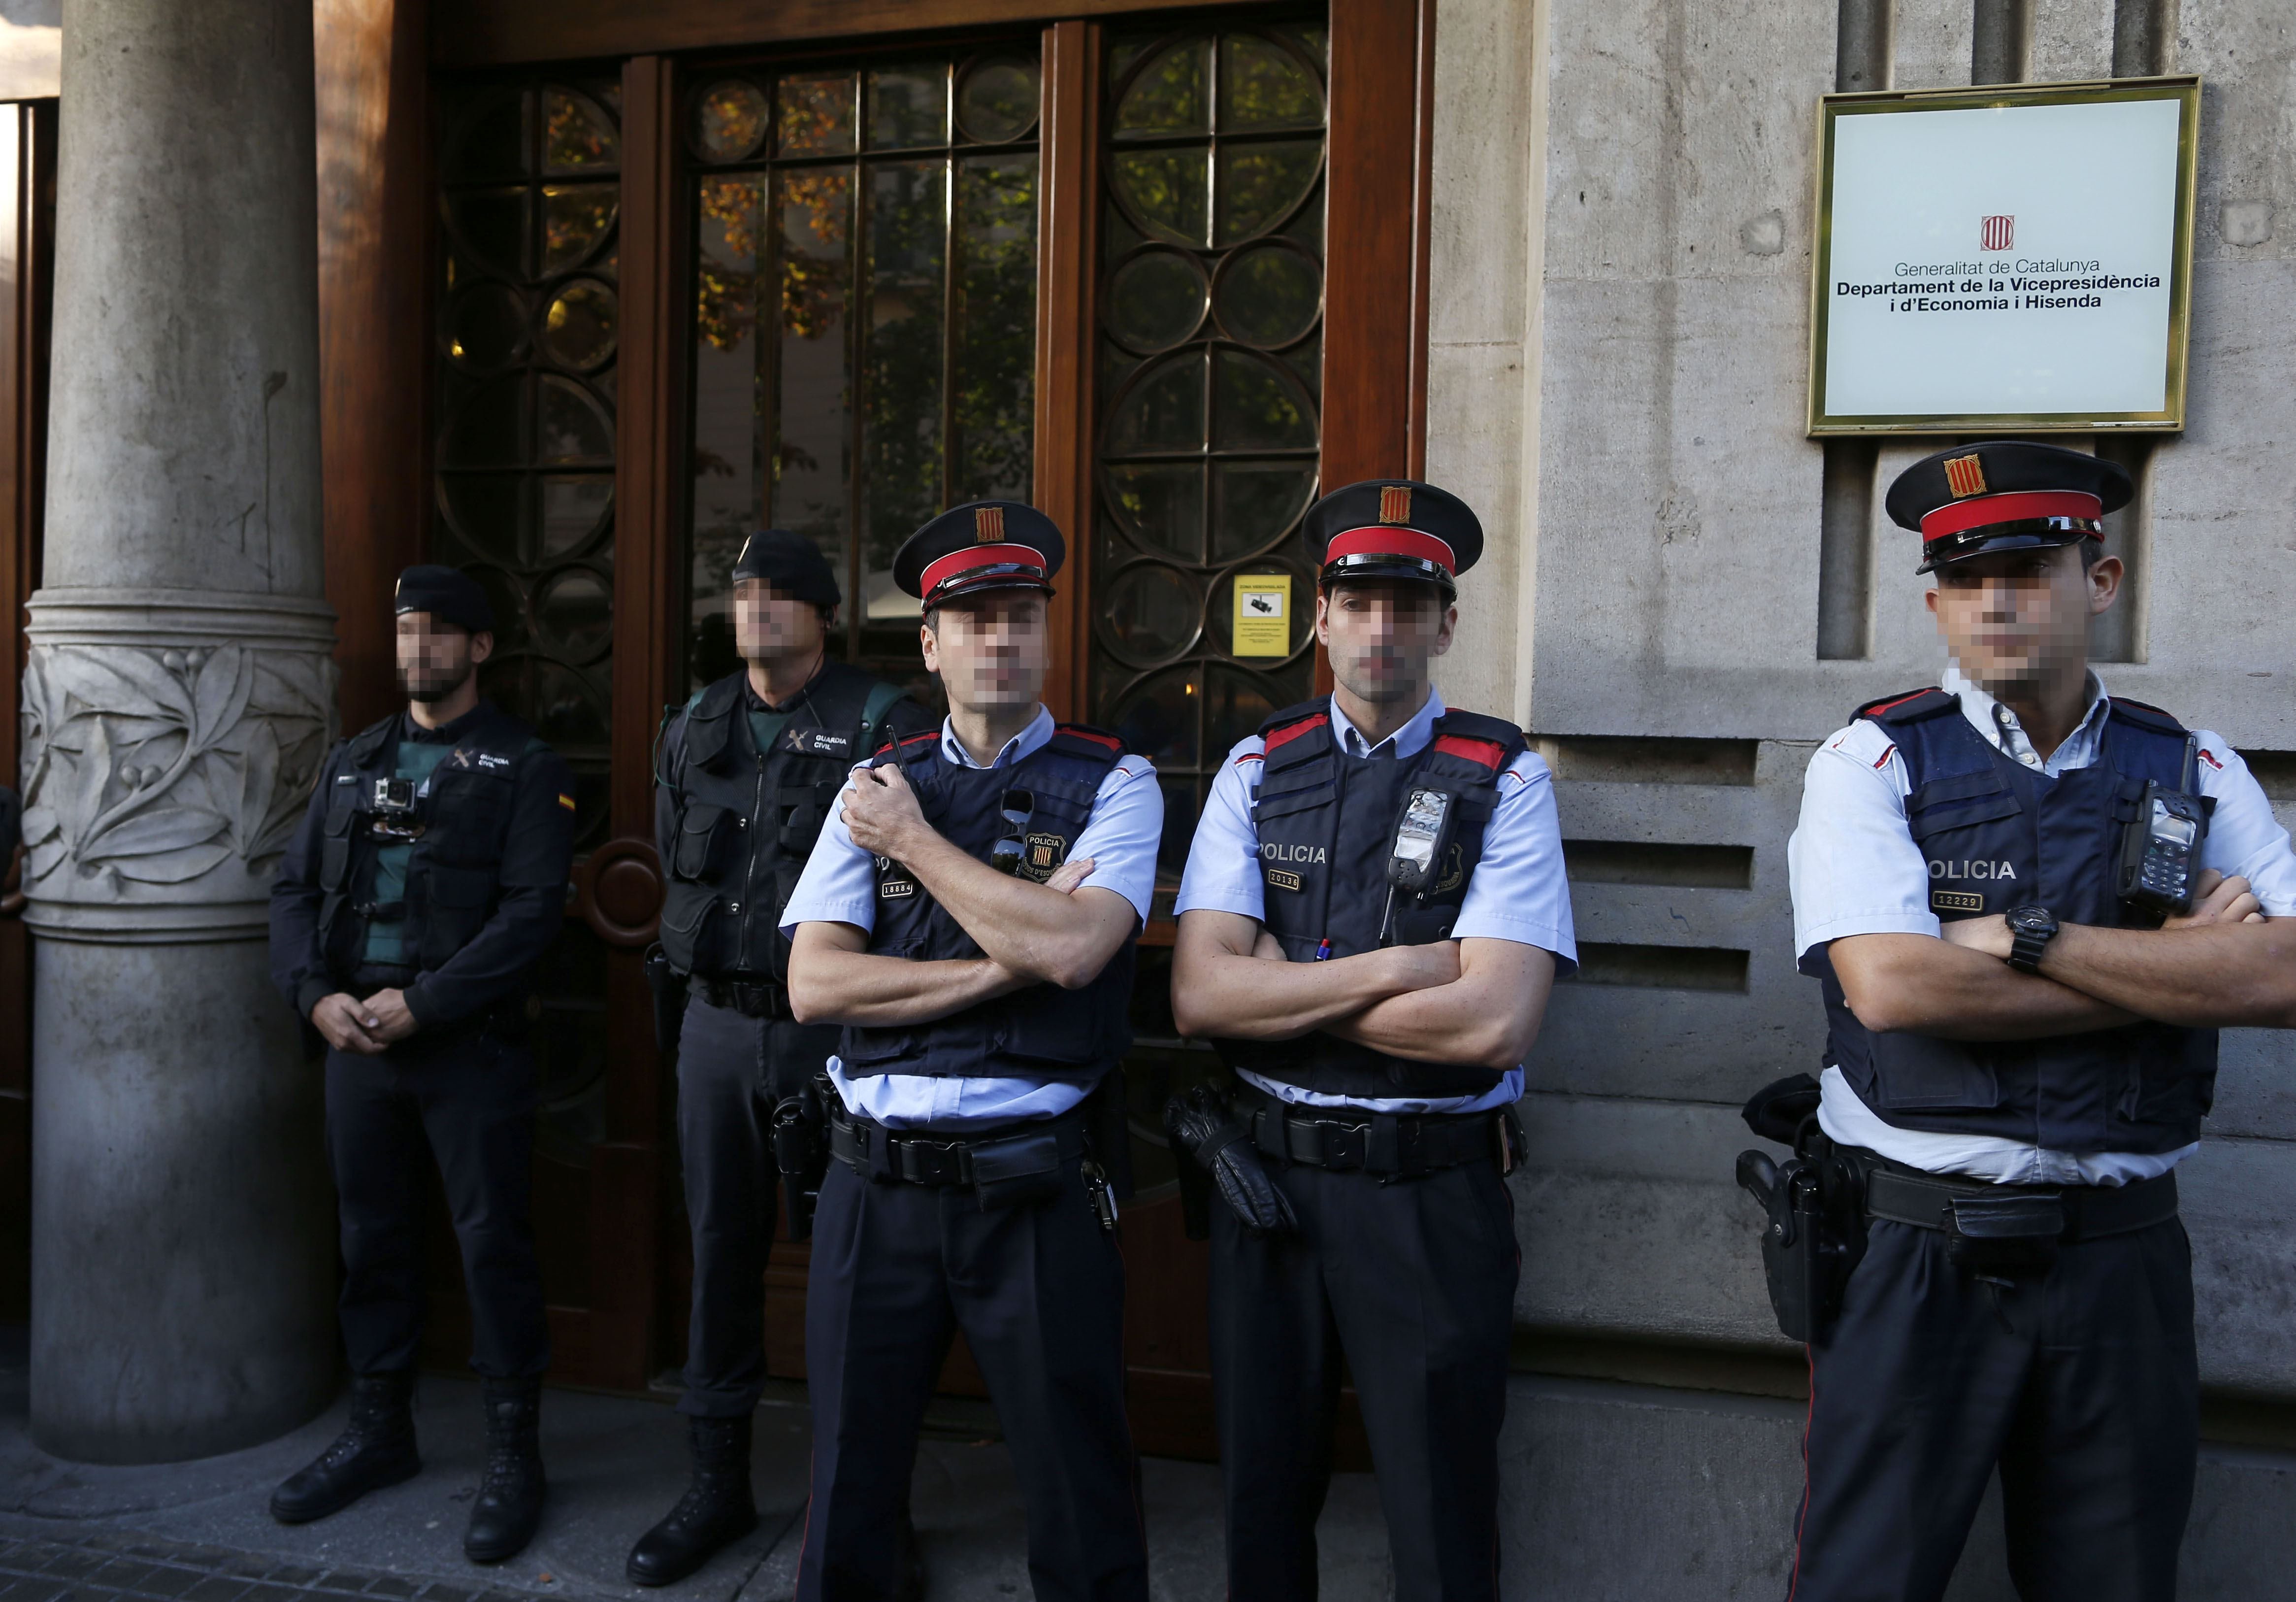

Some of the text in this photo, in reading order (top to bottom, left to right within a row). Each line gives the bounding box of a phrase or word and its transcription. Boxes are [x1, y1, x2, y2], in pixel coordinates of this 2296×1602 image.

[1895, 259, 2100, 276] Generalitat de Catalunya
[1837, 274, 2160, 298] Departament de la Vicepresidència
[1890, 294, 2101, 311] i d'Economia i Hisenda
[816, 734, 847, 745] GUARDIA
[814, 741, 831, 750] CIVIL
[478, 760, 495, 768] CIVIL
[480, 754, 509, 765] GUARDIA
[1029, 836, 1059, 847] POLICIA
[1928, 860, 2017, 879] OLICIA
[1271, 873, 1297, 886] 20136
[885, 884, 910, 893] 18884
[1939, 896, 1976, 906] 12229
